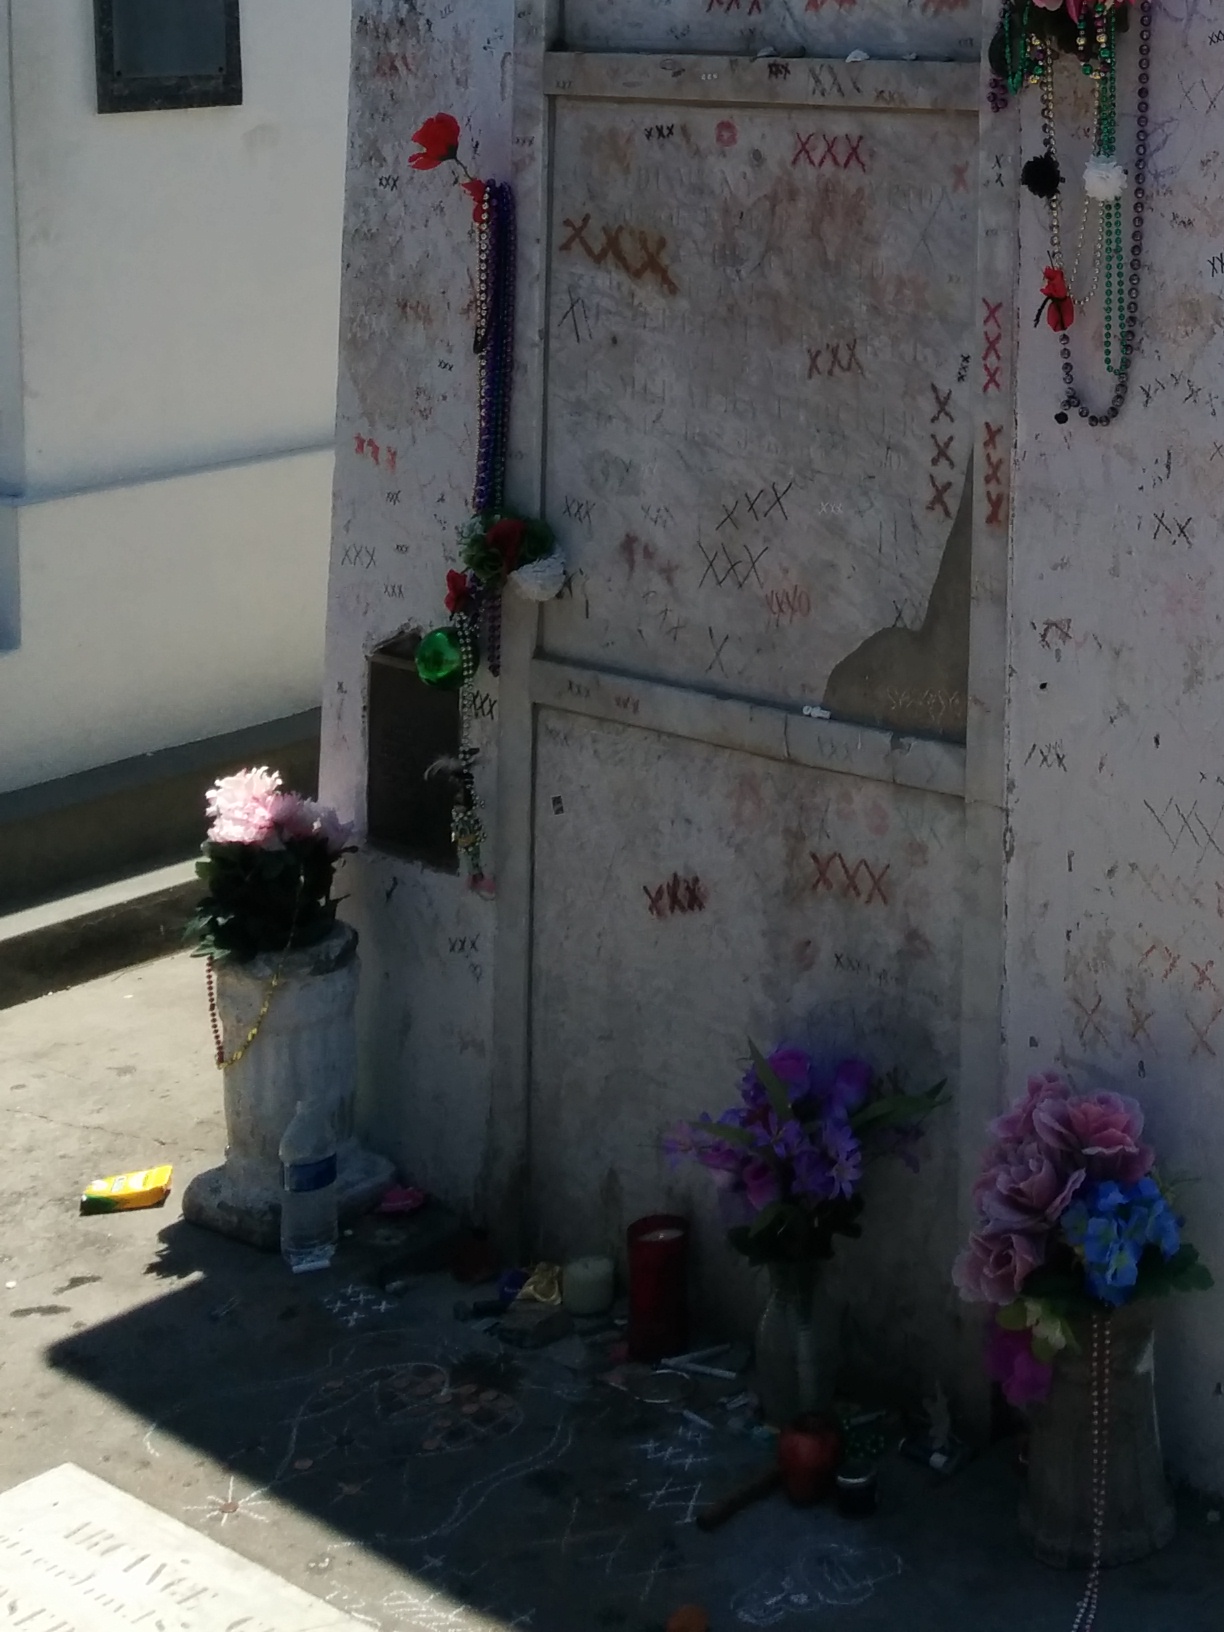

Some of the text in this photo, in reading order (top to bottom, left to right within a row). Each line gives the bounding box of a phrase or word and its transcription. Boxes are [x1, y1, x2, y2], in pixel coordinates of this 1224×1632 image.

[643, 123, 675, 141] XXX
[791, 132, 866, 174] XXX
[378, 175, 399, 191] XXX
[559, 212, 681, 297] XXX
[806, 338, 866, 380] XXX
[715, 476, 796, 531] XXX
[819, 502, 844, 515] XXX
[341, 544, 377, 569] XXX
[696, 539, 769, 590] XXX
[808, 849, 890, 907] XXX
